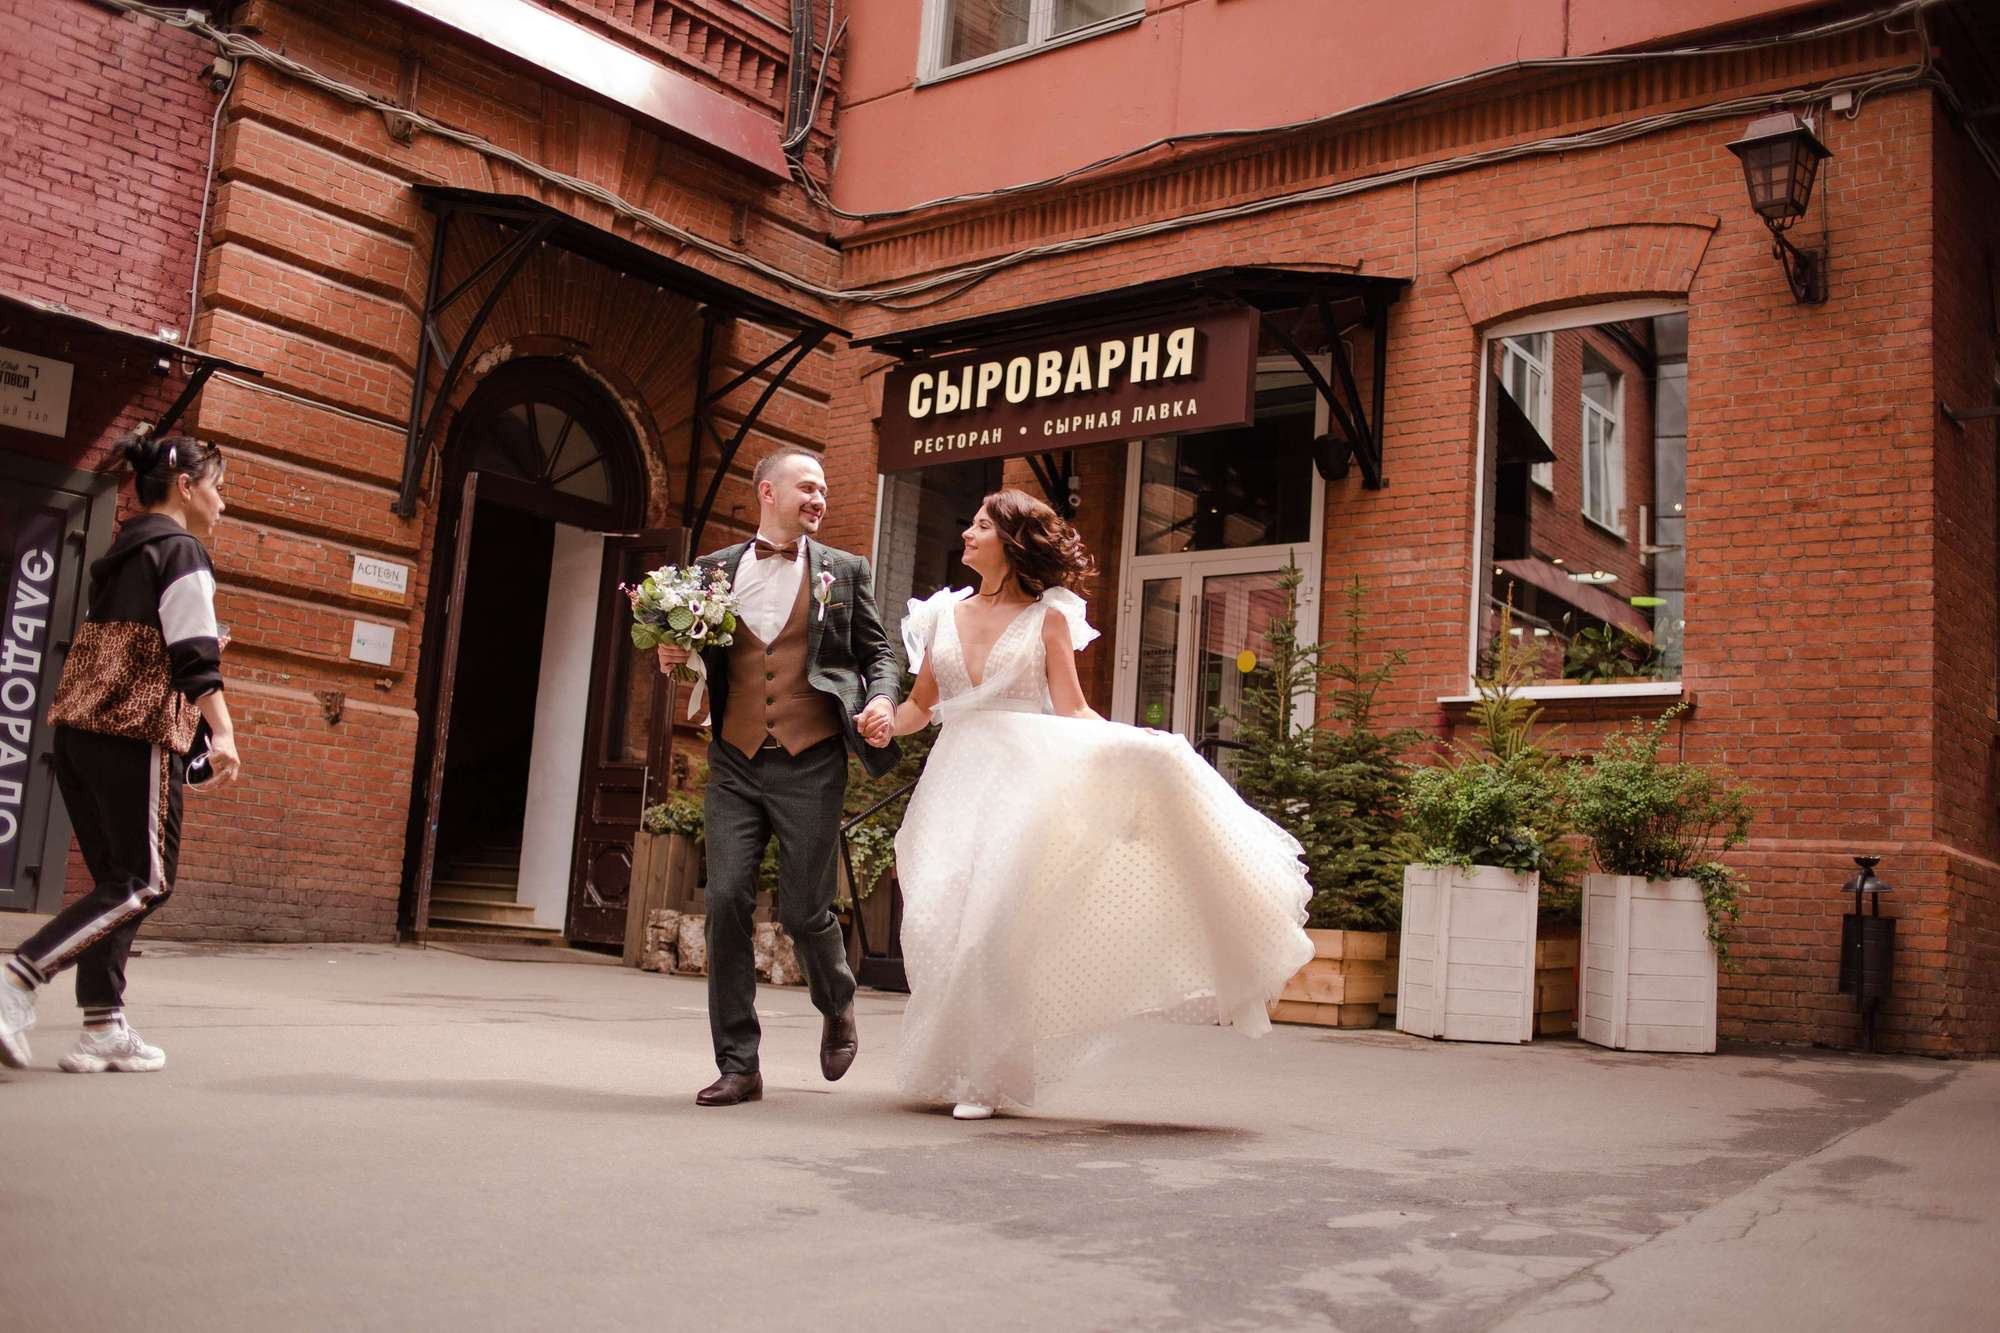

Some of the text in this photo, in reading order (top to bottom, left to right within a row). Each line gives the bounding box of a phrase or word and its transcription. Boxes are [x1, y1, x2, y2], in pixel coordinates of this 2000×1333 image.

[907, 326, 1196, 419] СЫРОВАРНЯ
[913, 398, 1198, 456] РЕСТОРАН СЫРНАЯ ЛАВКА
